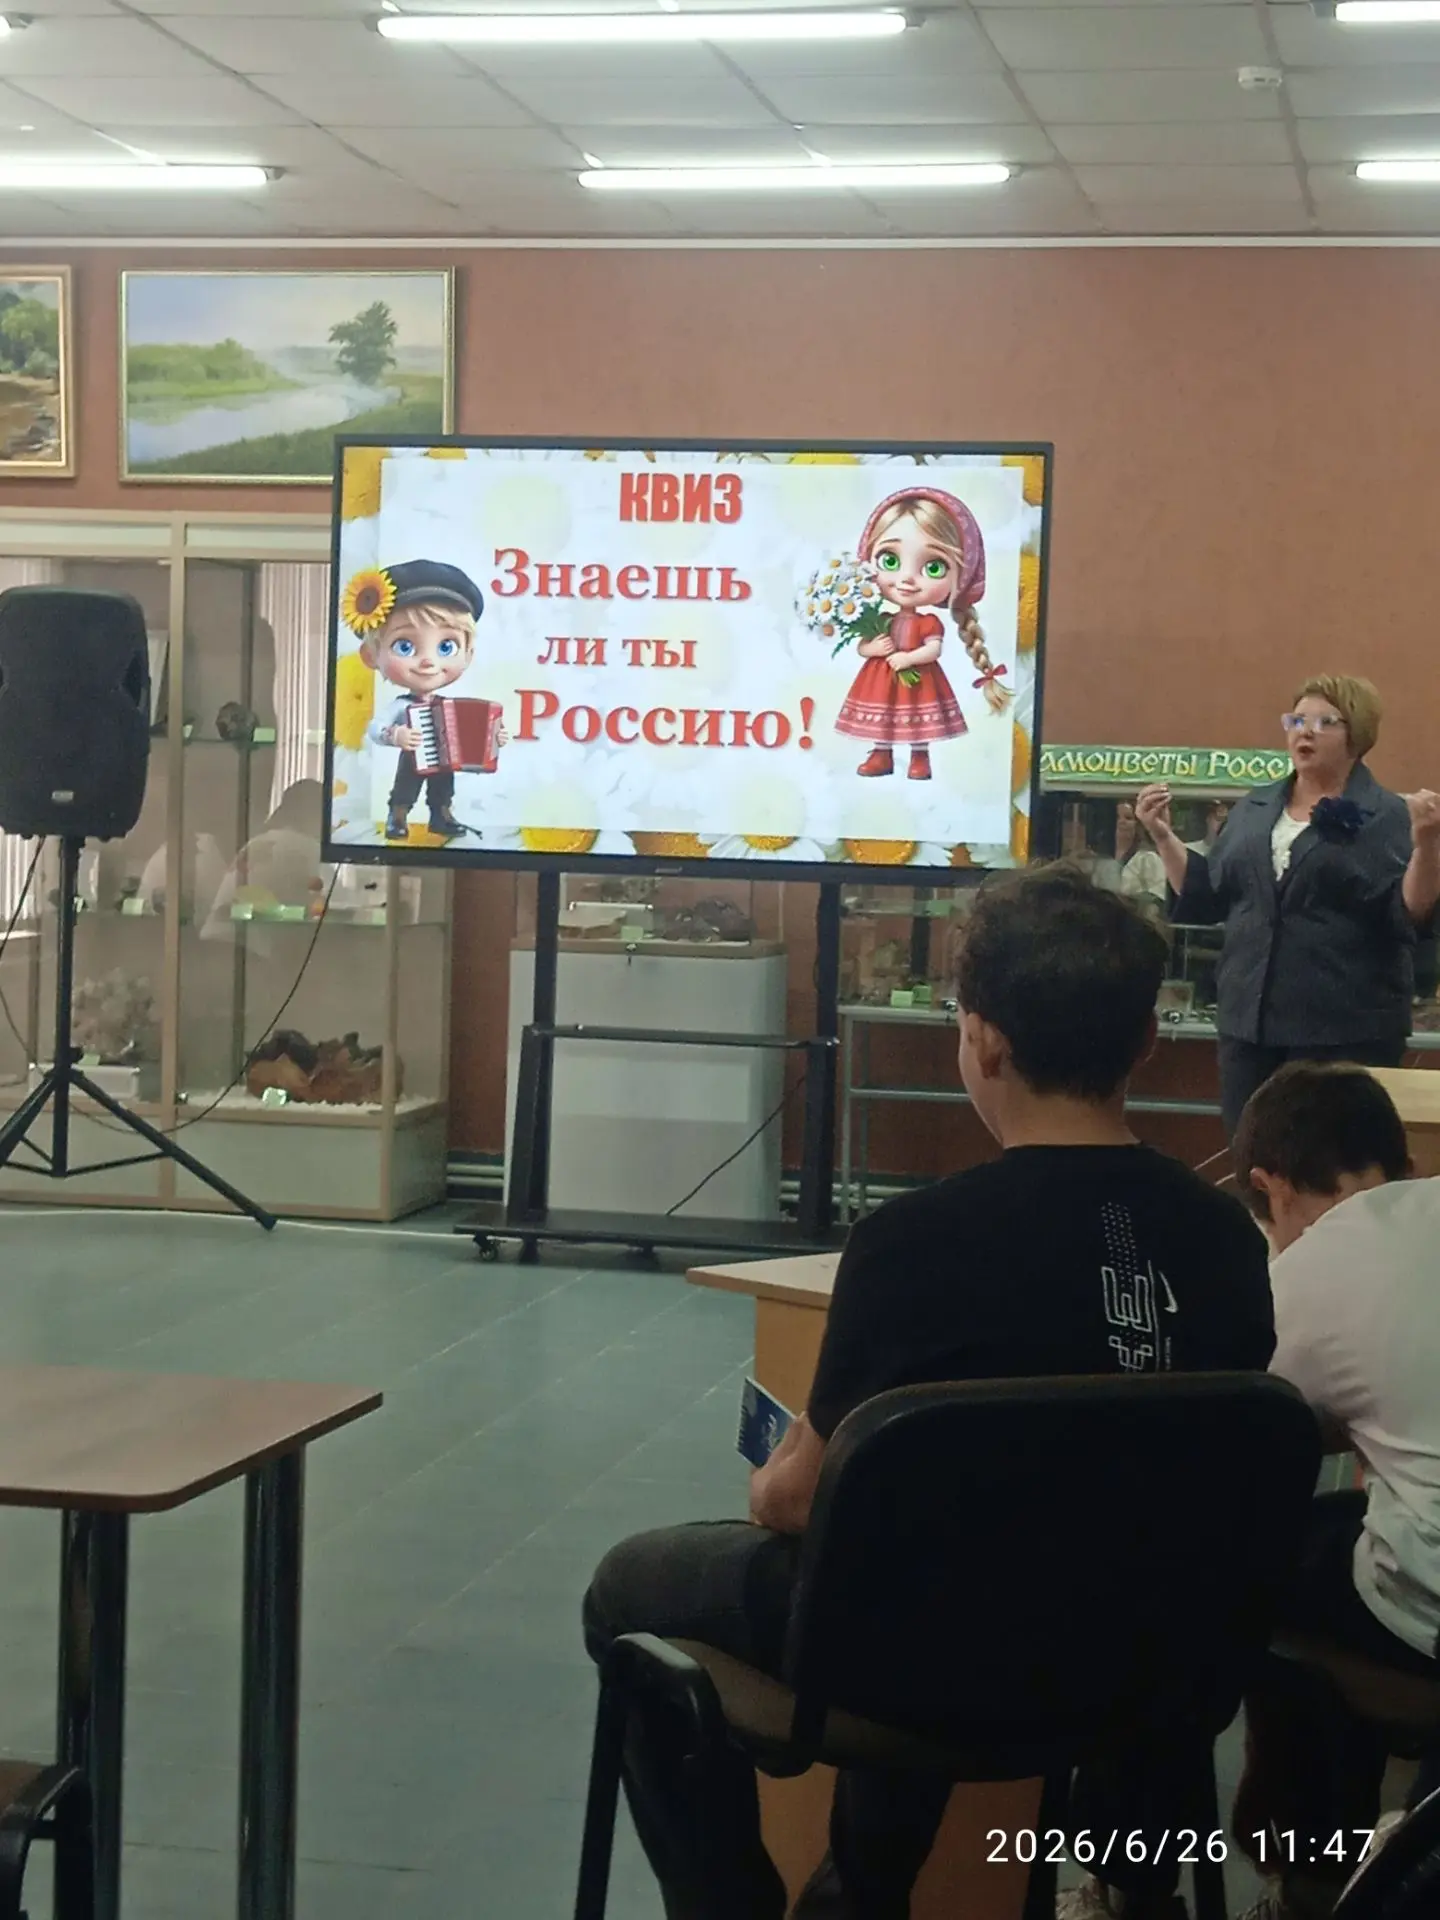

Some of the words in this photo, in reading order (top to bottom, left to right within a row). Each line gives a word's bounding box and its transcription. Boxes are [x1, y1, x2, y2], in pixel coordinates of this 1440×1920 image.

[619, 473, 743, 523] КВИЗ
[491, 548, 752, 603] Знаешь
[537, 637, 607, 668] ли
[623, 638, 697, 669] ты
[513, 689, 815, 750] Россию!
[1040, 751, 1197, 776] амоцветы
